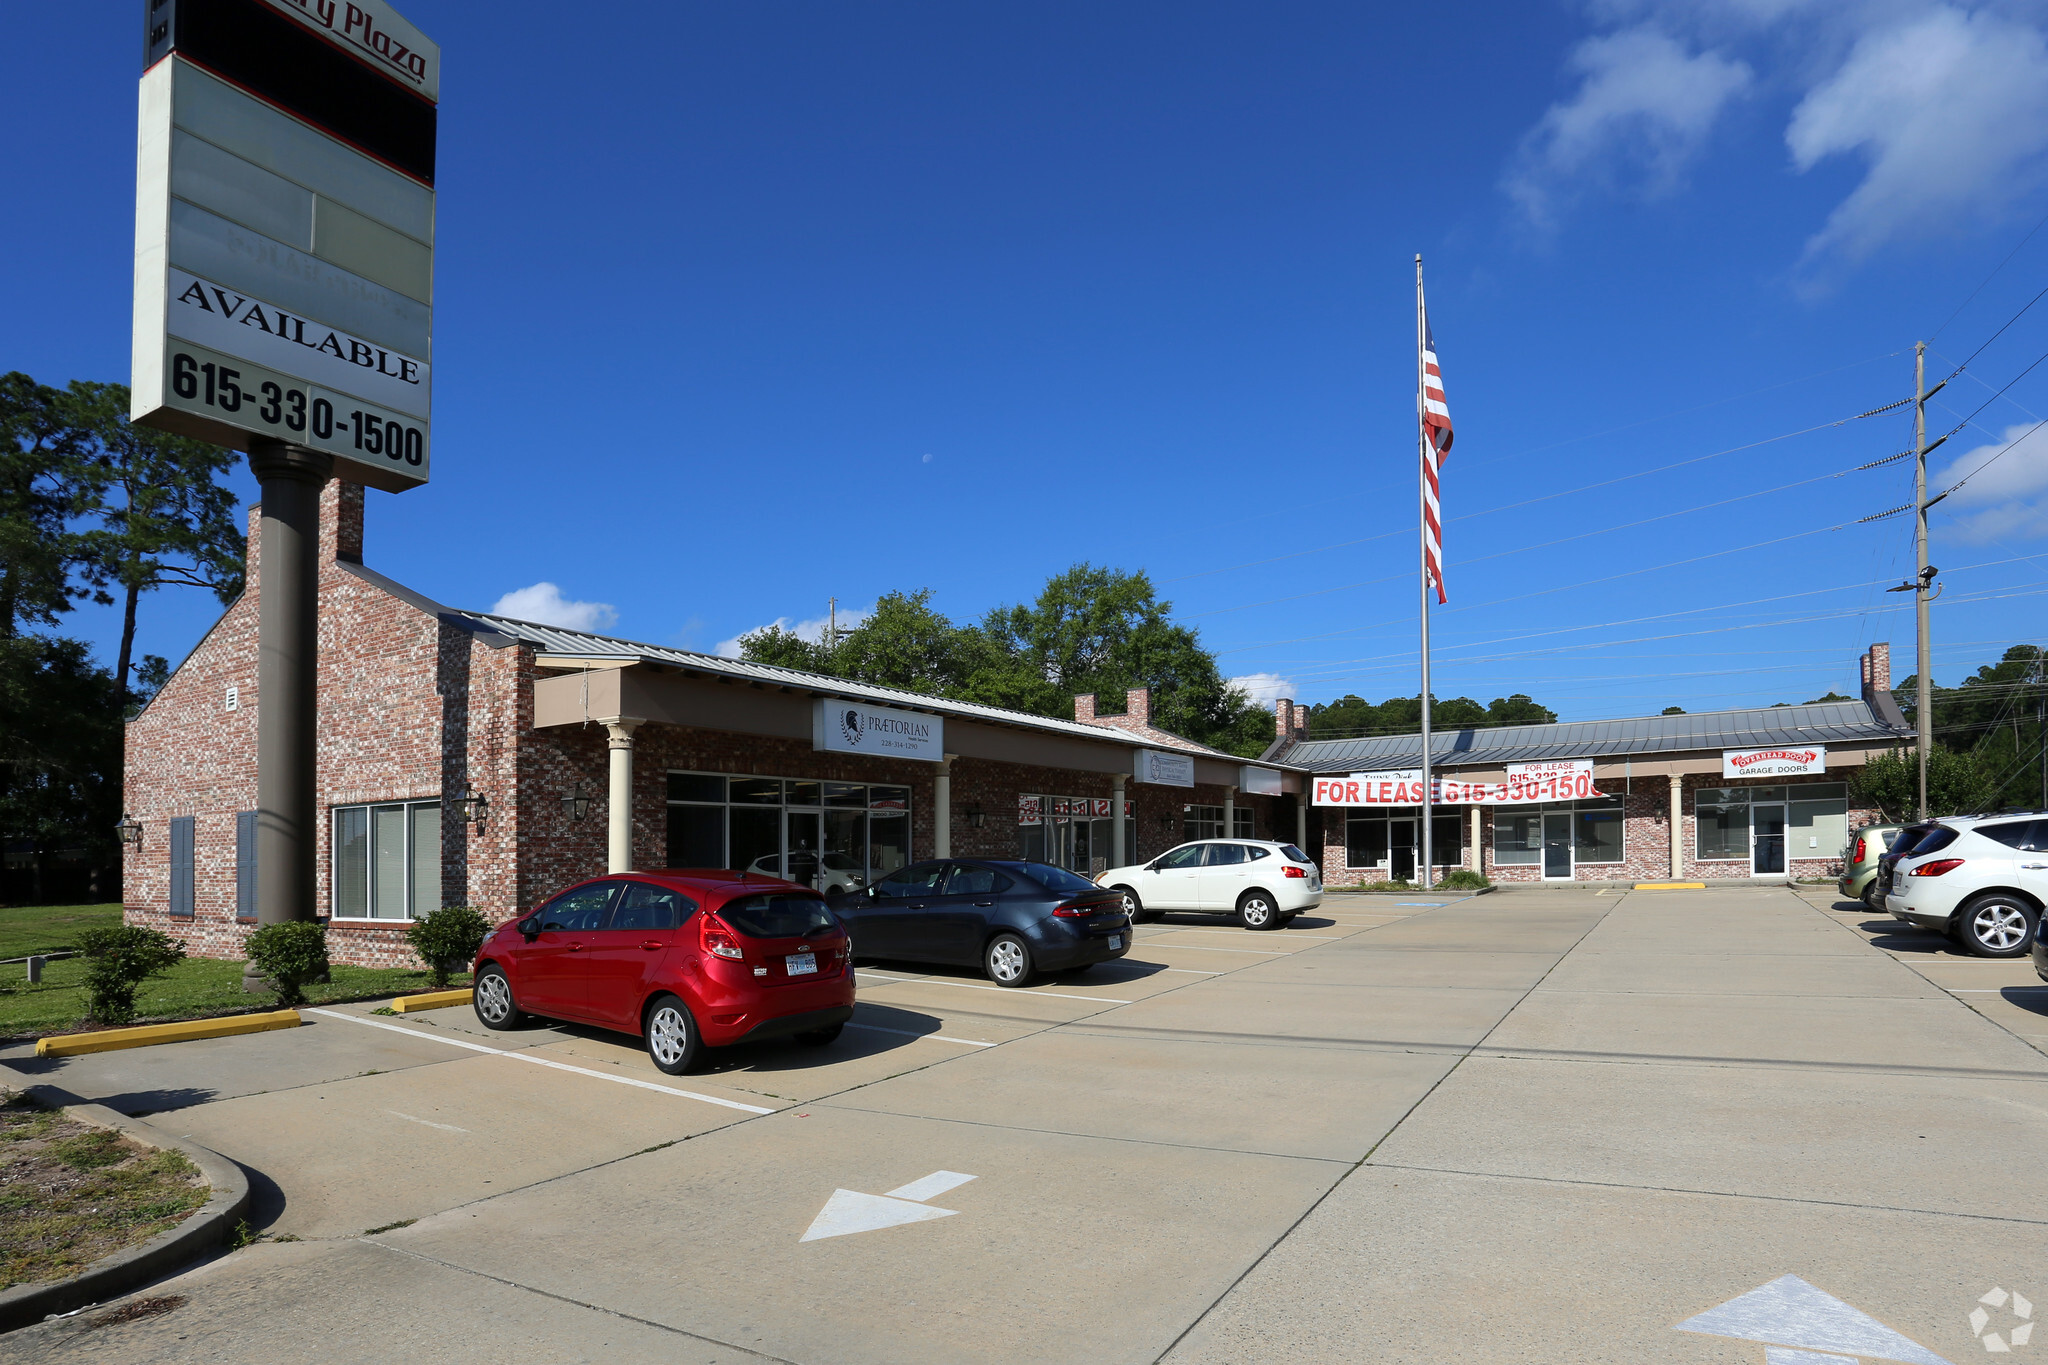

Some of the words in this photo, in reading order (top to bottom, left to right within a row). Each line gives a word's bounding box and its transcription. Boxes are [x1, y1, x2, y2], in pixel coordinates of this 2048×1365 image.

[344, 2, 426, 80] Plaza
[177, 280, 420, 385] AVAILABLE
[173, 353, 423, 466] 615-330-1500
[868, 716, 929, 737] PRÆTORIAN
[1525, 764, 1542, 772] FOR
[1547, 762, 1575, 771] LEASE
[1740, 751, 1783, 766] OVERHEAD
[1785, 753, 1807, 763] DOOR
[1739, 767, 1773, 775] GARAGE
[1778, 765, 1808, 773] DOORS
[1316, 781, 1360, 803] FOR
